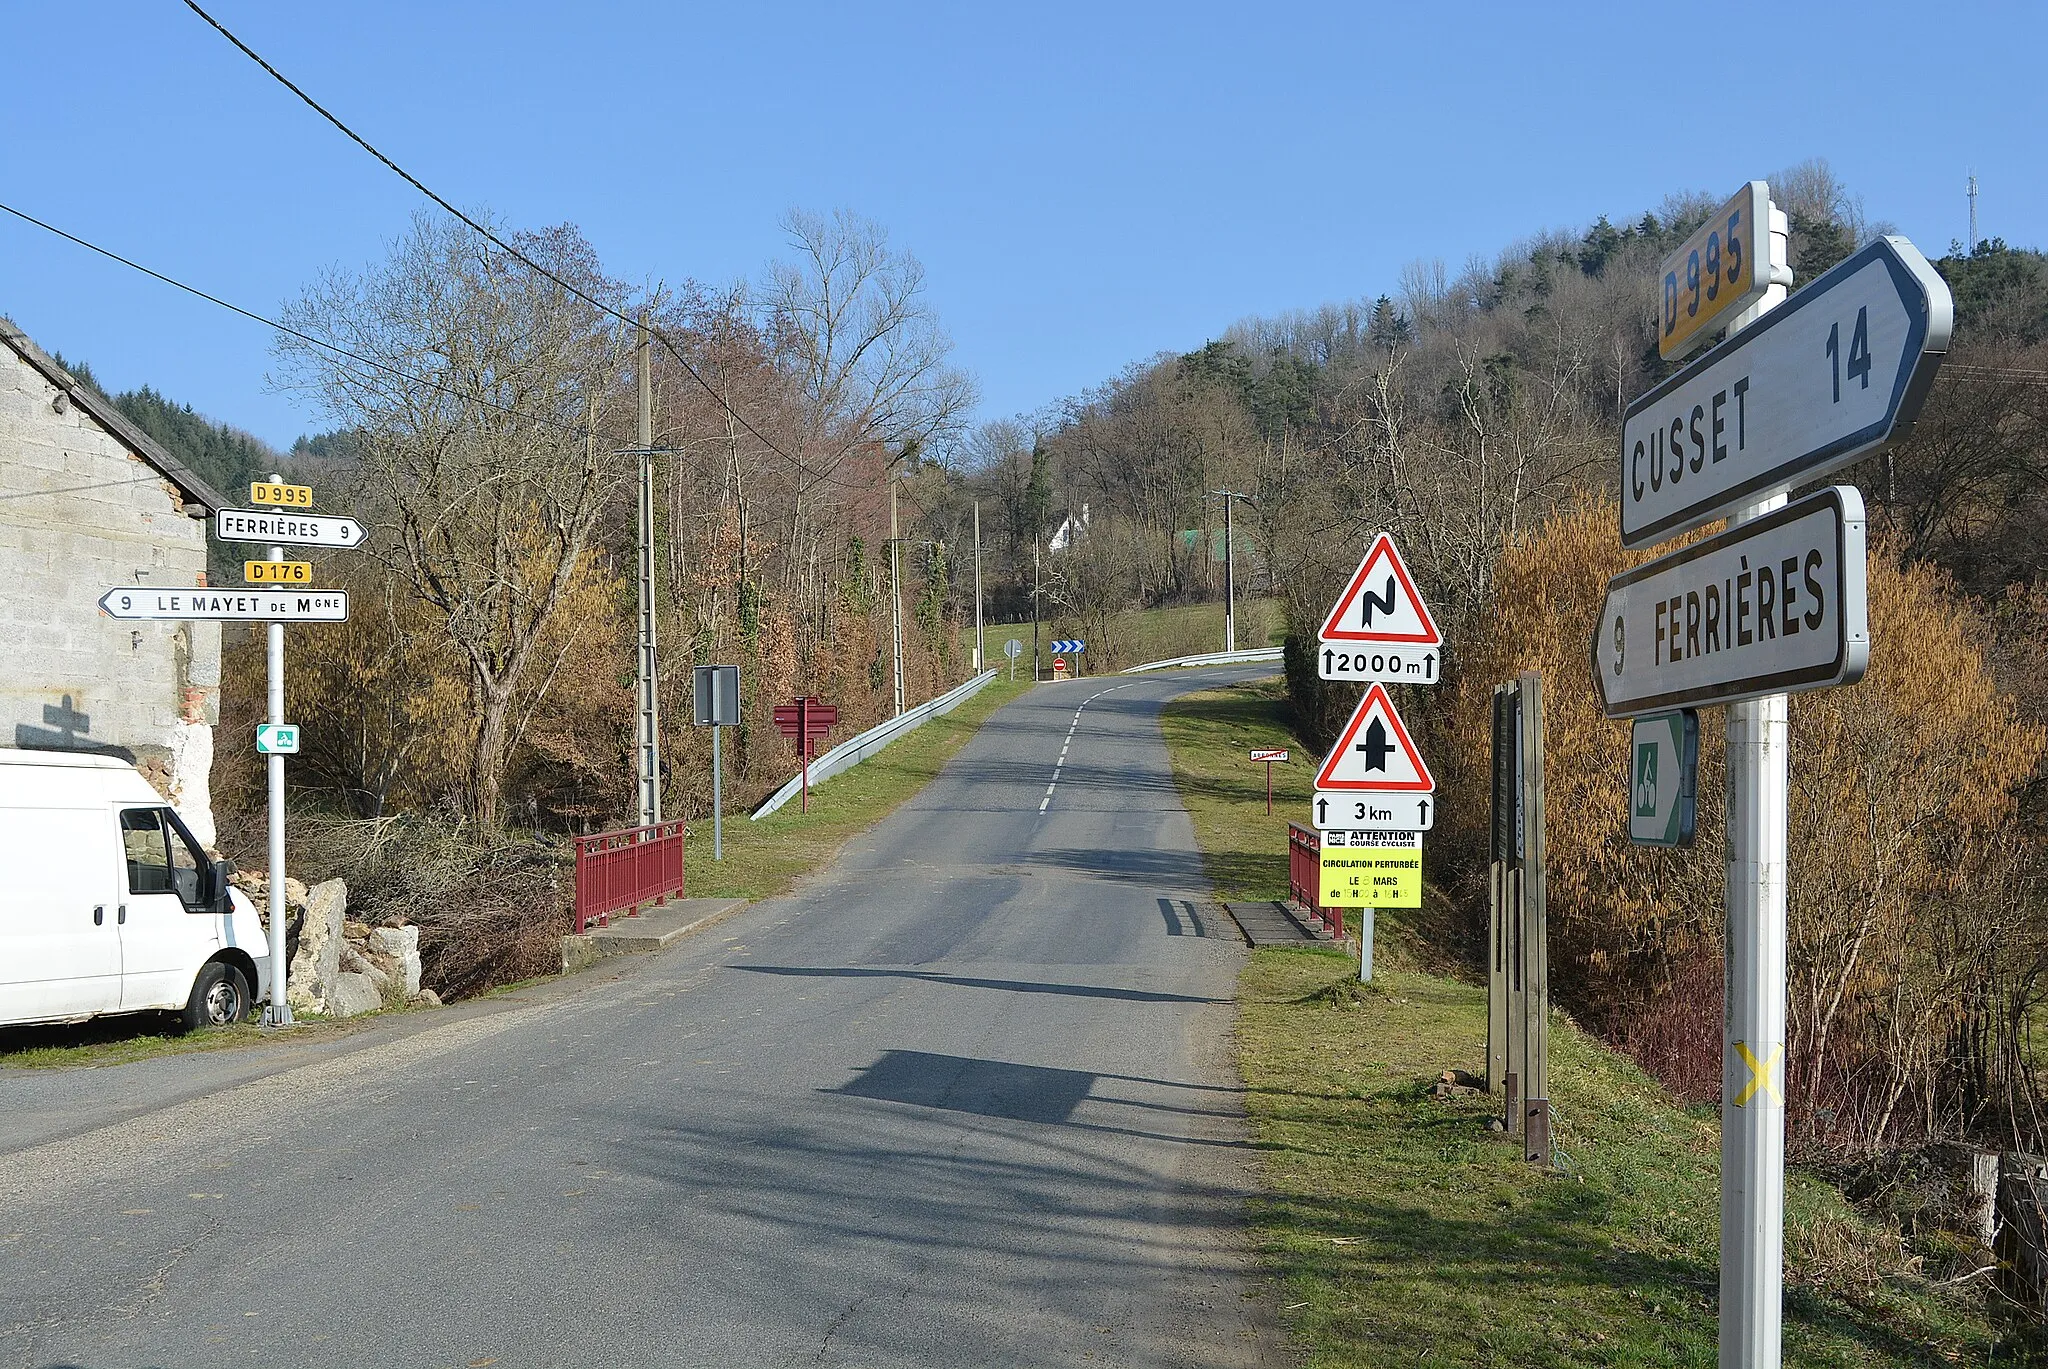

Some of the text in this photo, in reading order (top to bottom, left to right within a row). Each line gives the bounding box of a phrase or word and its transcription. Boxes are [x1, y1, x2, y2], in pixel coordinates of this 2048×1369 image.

[1664, 208, 1742, 337] D 995
[1631, 305, 1872, 502] CUSSET 14
[257, 486, 307, 503] D 995
[225, 517, 349, 539] FERRIÈRES 9
[253, 565, 304, 579] D 176
[121, 596, 131, 610] 9
[157, 596, 180, 611] LE
[192, 597, 260, 612] MAYET
[270, 602, 286, 613] DE
[1613, 548, 1825, 676] 9 FERRIÈRES
[1337, 654, 1421, 675] 2000 m
[1354, 802, 1392, 821] 3 km
[1350, 831, 1415, 841] ATTENTION
[1322, 859, 1419, 869] CIRCULATION PERTURBÉE
[1349, 877, 1359, 885] LE
[1373, 877, 1398, 886] MARS
[1330, 889, 1341, 898] de
[1372, 889, 1378, 898] à
